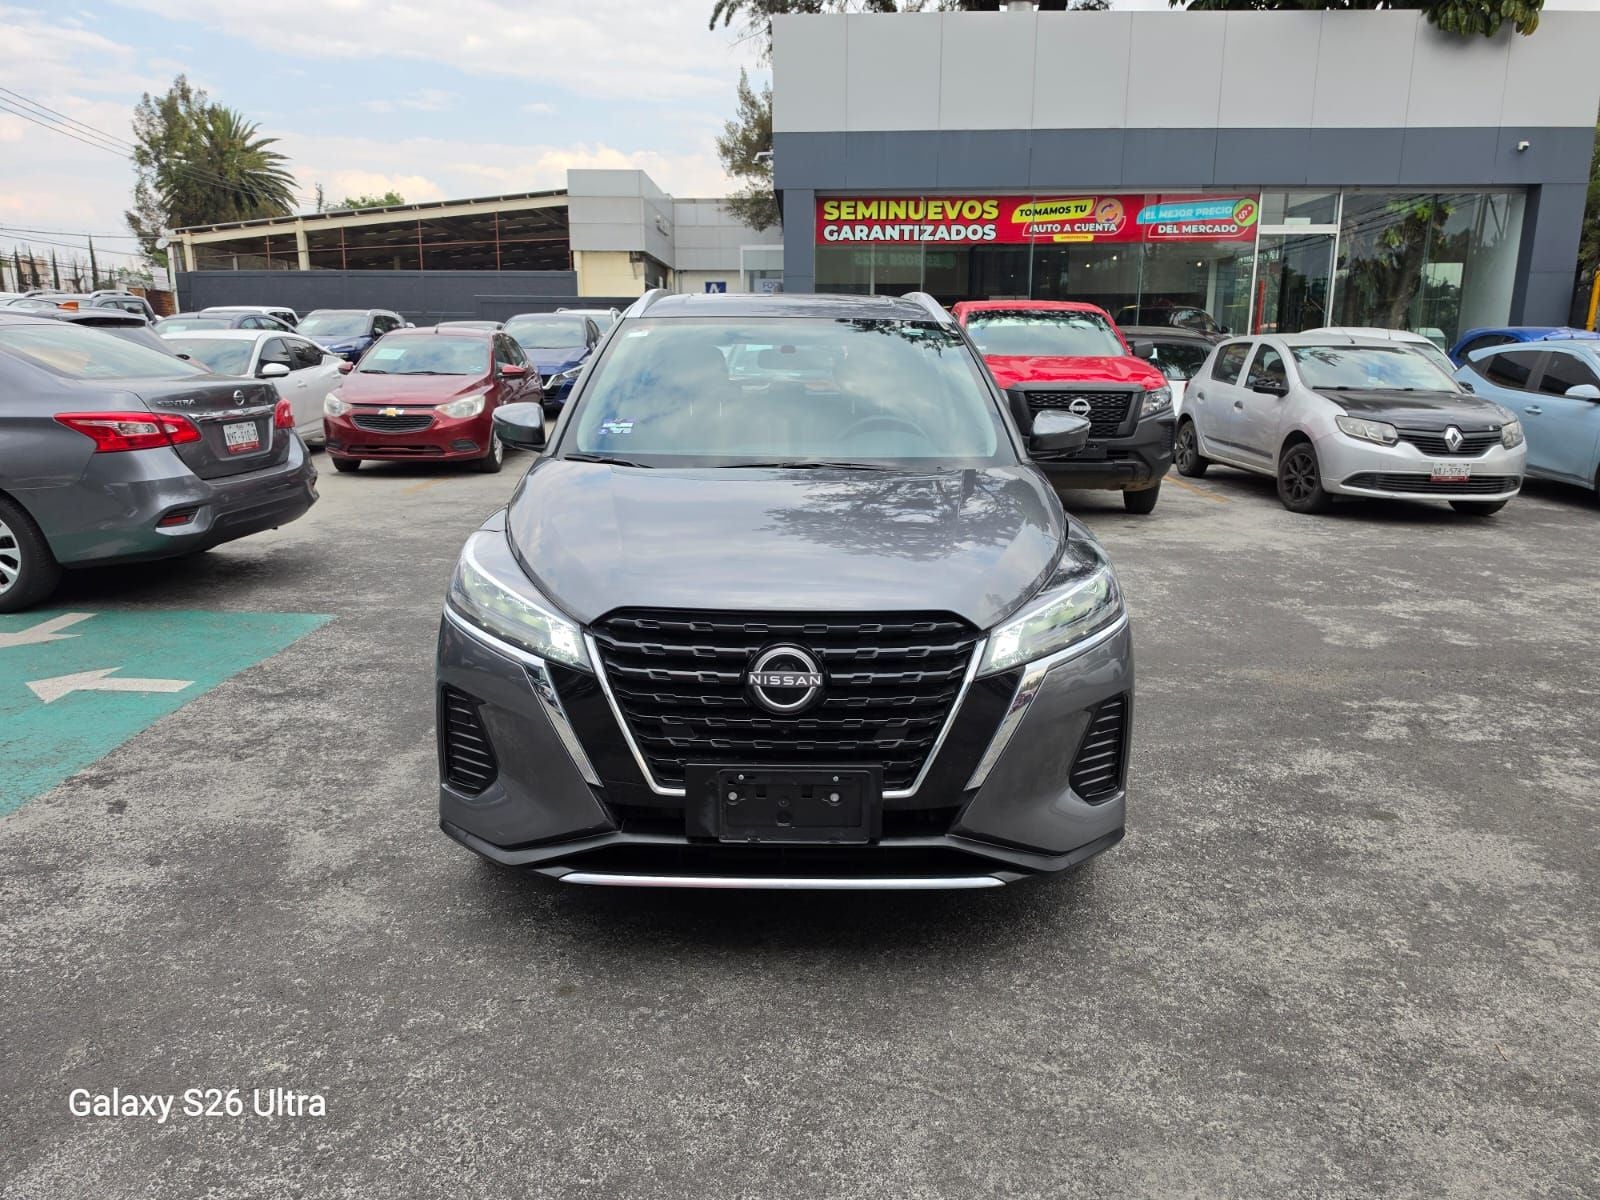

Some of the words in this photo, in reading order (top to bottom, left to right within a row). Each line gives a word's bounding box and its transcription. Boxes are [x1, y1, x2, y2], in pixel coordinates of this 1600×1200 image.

[823, 200, 999, 221] SEMINUEVOS
[1019, 205, 1071, 217] TOMAMOS
[1072, 204, 1087, 214] TU
[1145, 210, 1156, 219] EL
[1158, 207, 1194, 219] MEJOR
[1195, 206, 1232, 217] PRECIO
[823, 224, 997, 242] GARANTIZADOS
[1030, 223, 1061, 233] AUTO
[1063, 223, 1072, 232] A
[1075, 222, 1117, 233] CUENTA
[1158, 225, 1179, 234] DEL
[1181, 224, 1238, 234] MERCADO
[749, 674, 821, 686] NISSAN
